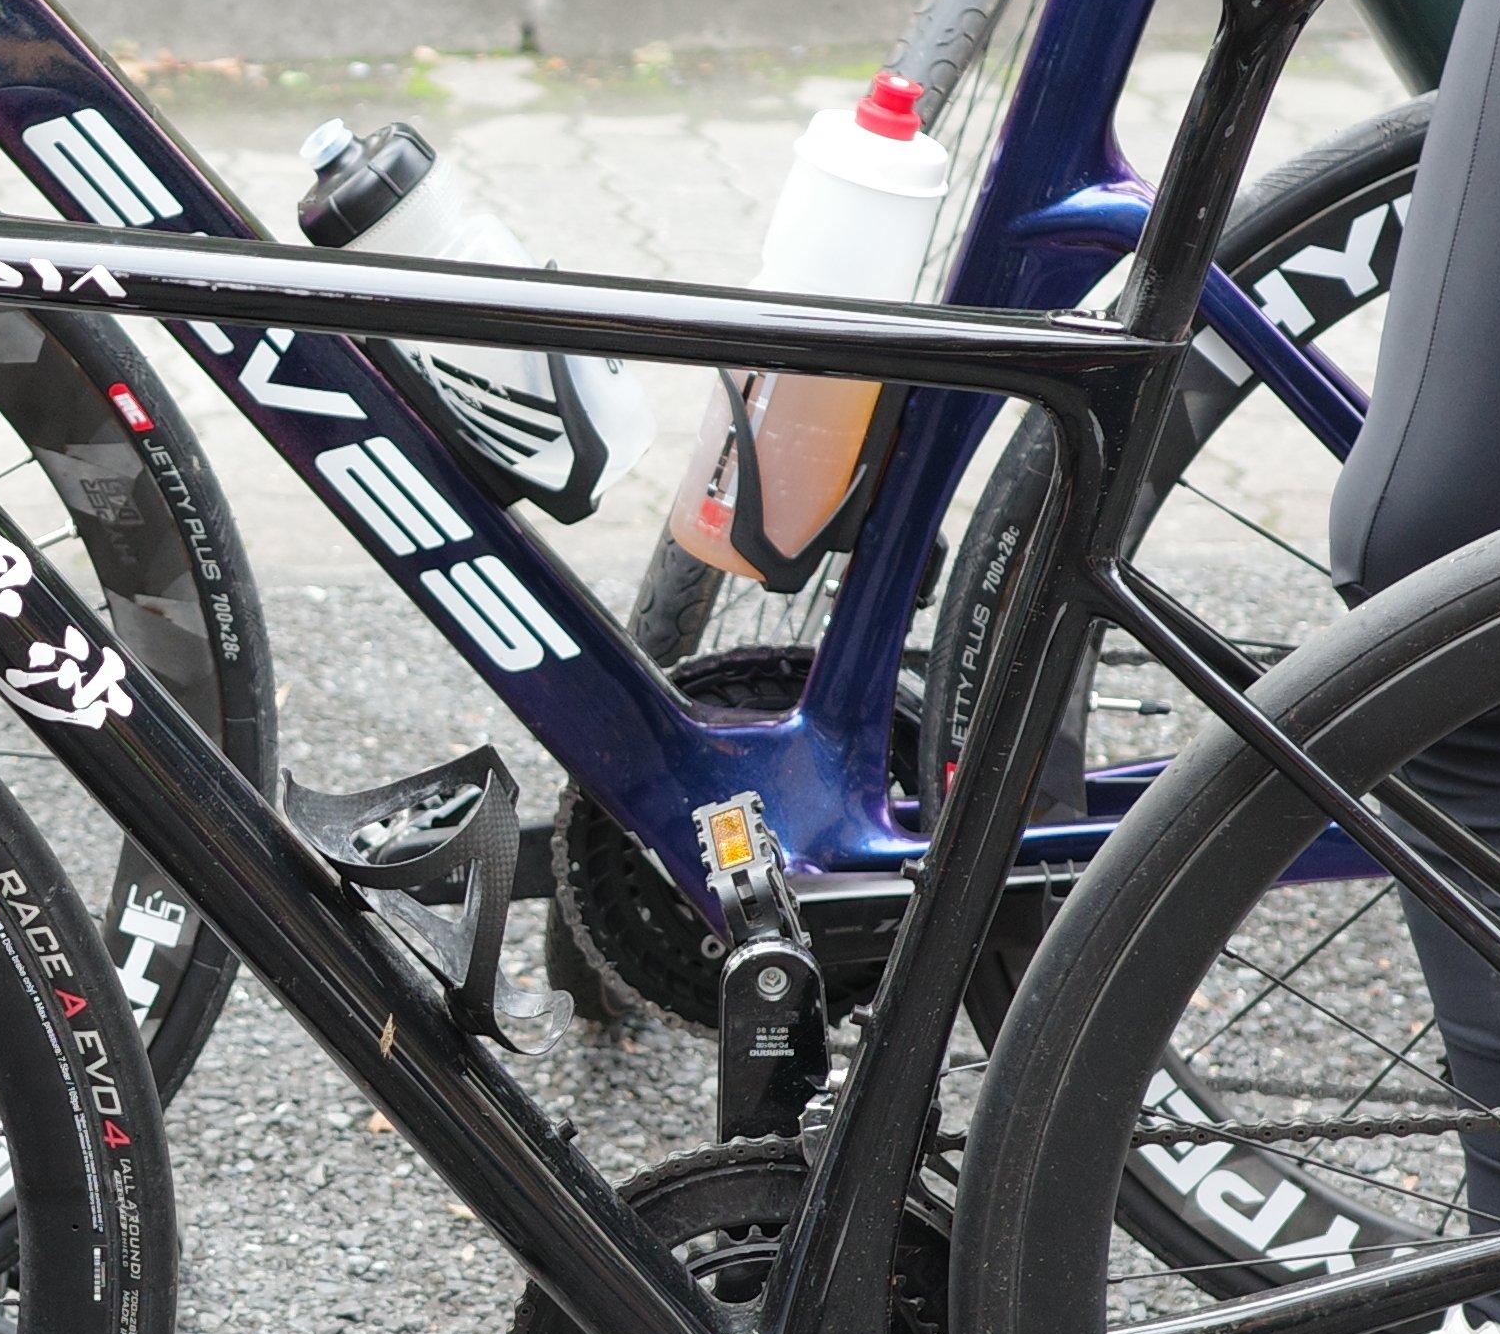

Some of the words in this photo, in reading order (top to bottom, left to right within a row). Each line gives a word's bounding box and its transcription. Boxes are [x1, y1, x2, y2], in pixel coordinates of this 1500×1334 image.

[143, 437, 197, 513] JETTY
[184, 517, 221, 581] PLUS
[961, 603, 991, 672] PLUS
[55, 987, 89, 1018] A
[72, 1029, 123, 1116] EVO
[103, 1119, 132, 1149] 4
[749, 1048, 795, 1057] SHIMANO
[120, 1290, 132, 1325] MADE
